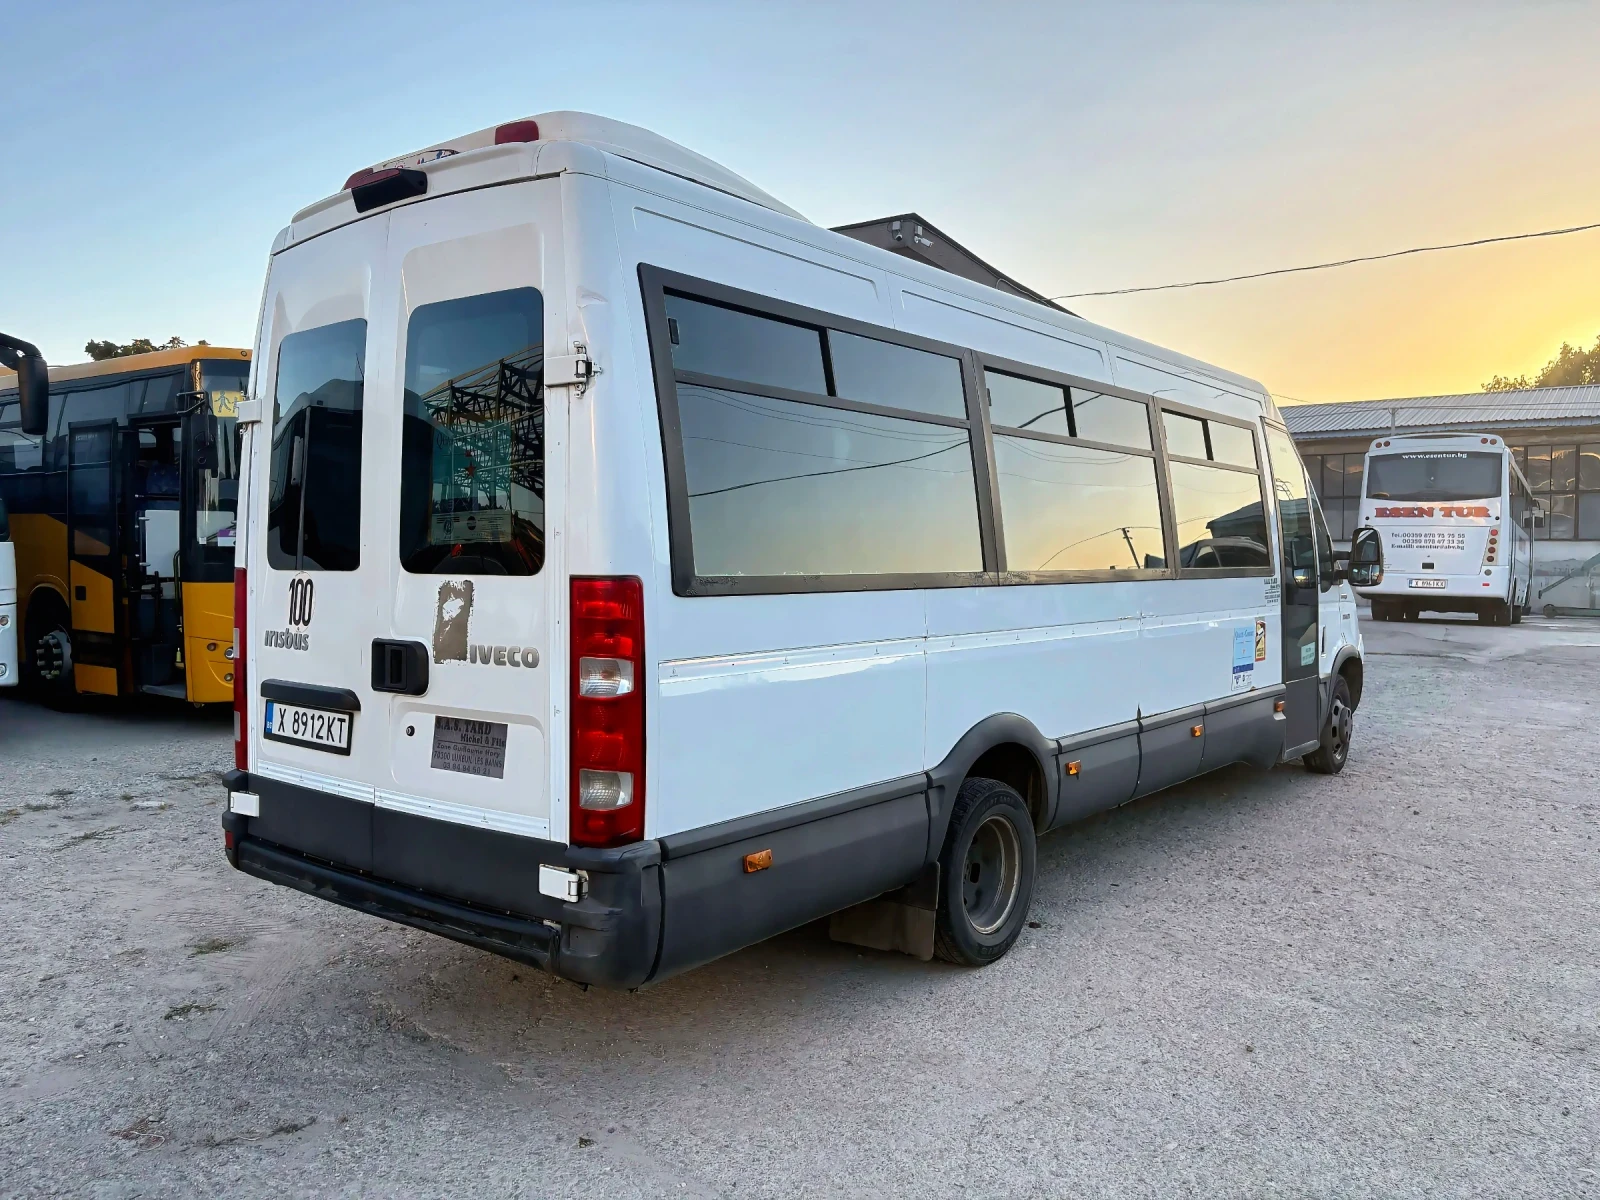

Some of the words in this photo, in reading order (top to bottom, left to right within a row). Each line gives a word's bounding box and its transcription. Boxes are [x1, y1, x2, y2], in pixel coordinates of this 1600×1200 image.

[1375, 507, 1434, 518] ESEN
[1439, 507, 1491, 518] TUR
[289, 578, 314, 627] 100
[264, 628, 310, 651] irisbus
[469, 644, 540, 669] IVECO
[278, 708, 286, 733] X
[292, 710, 346, 743] 8912KT
